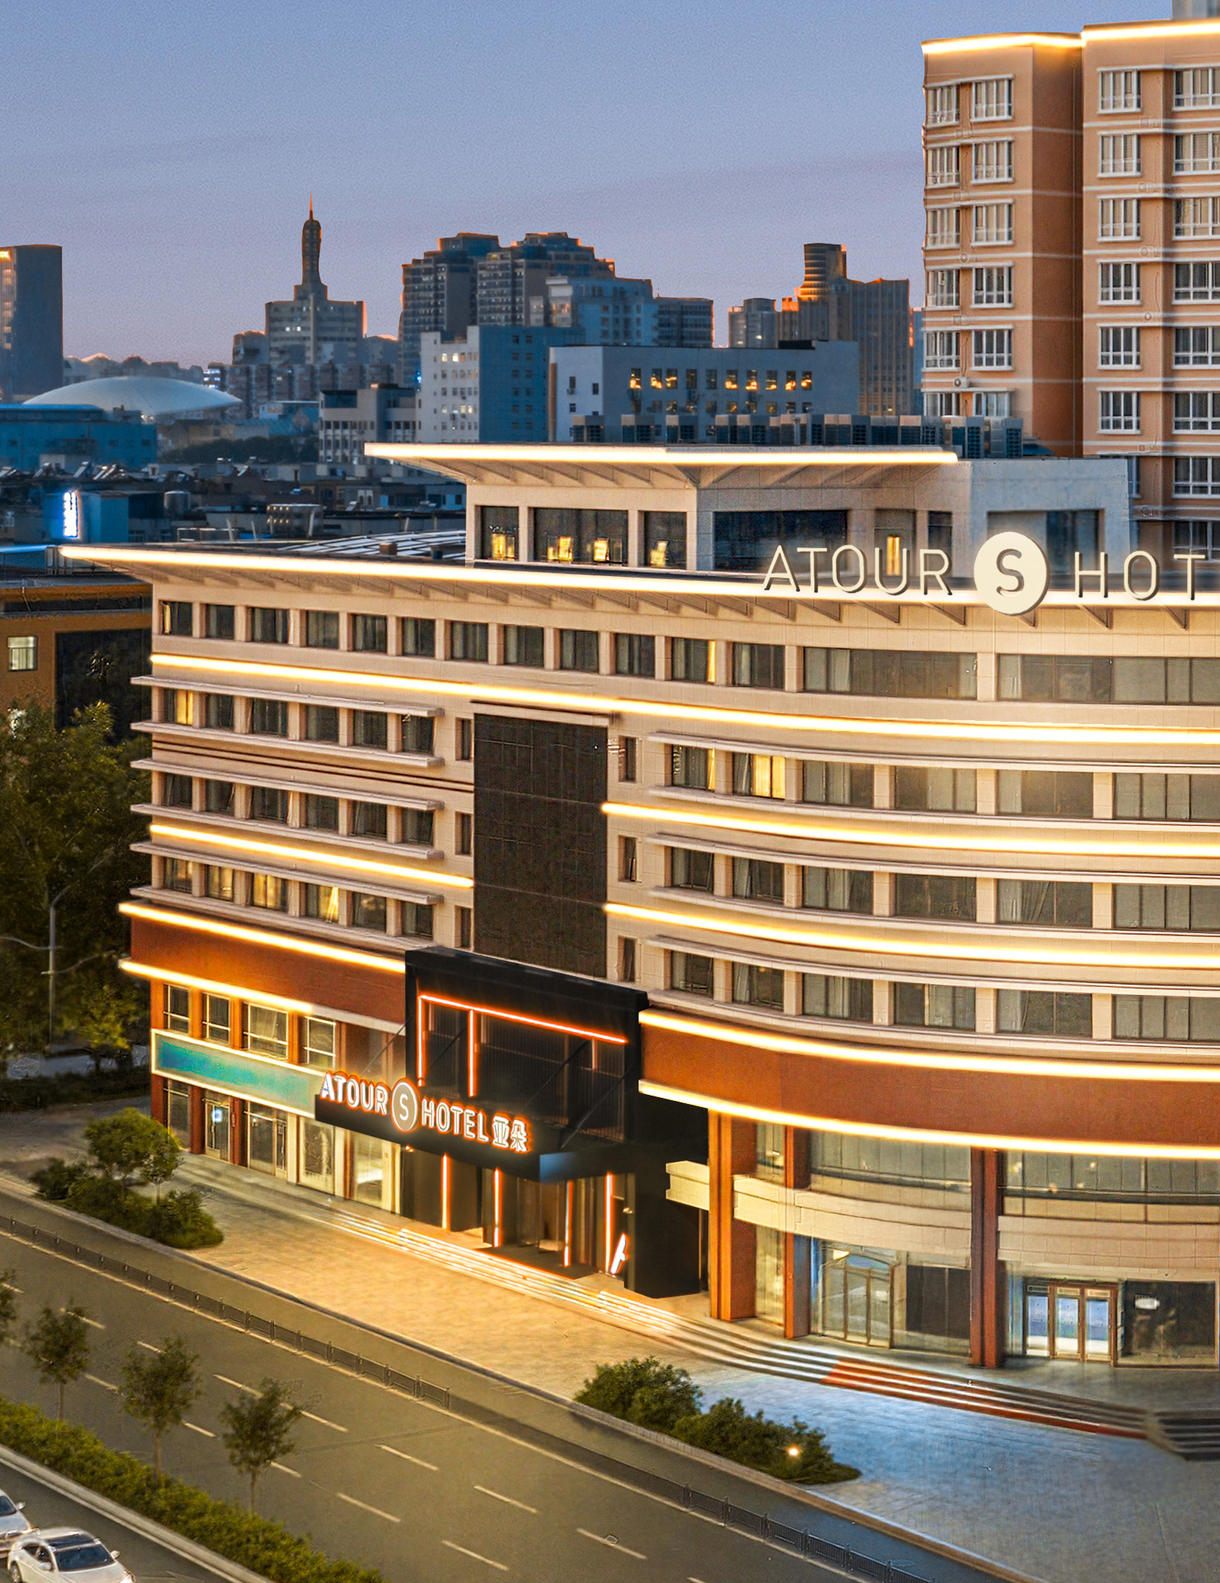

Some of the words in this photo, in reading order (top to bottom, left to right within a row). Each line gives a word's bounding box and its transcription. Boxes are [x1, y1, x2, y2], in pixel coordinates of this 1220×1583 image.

[761, 544, 953, 596] ATOUR
[320, 1071, 389, 1116] ATOUR
[421, 1097, 490, 1143] HOTEL
[492, 1114, 528, 1152] 亚朵
